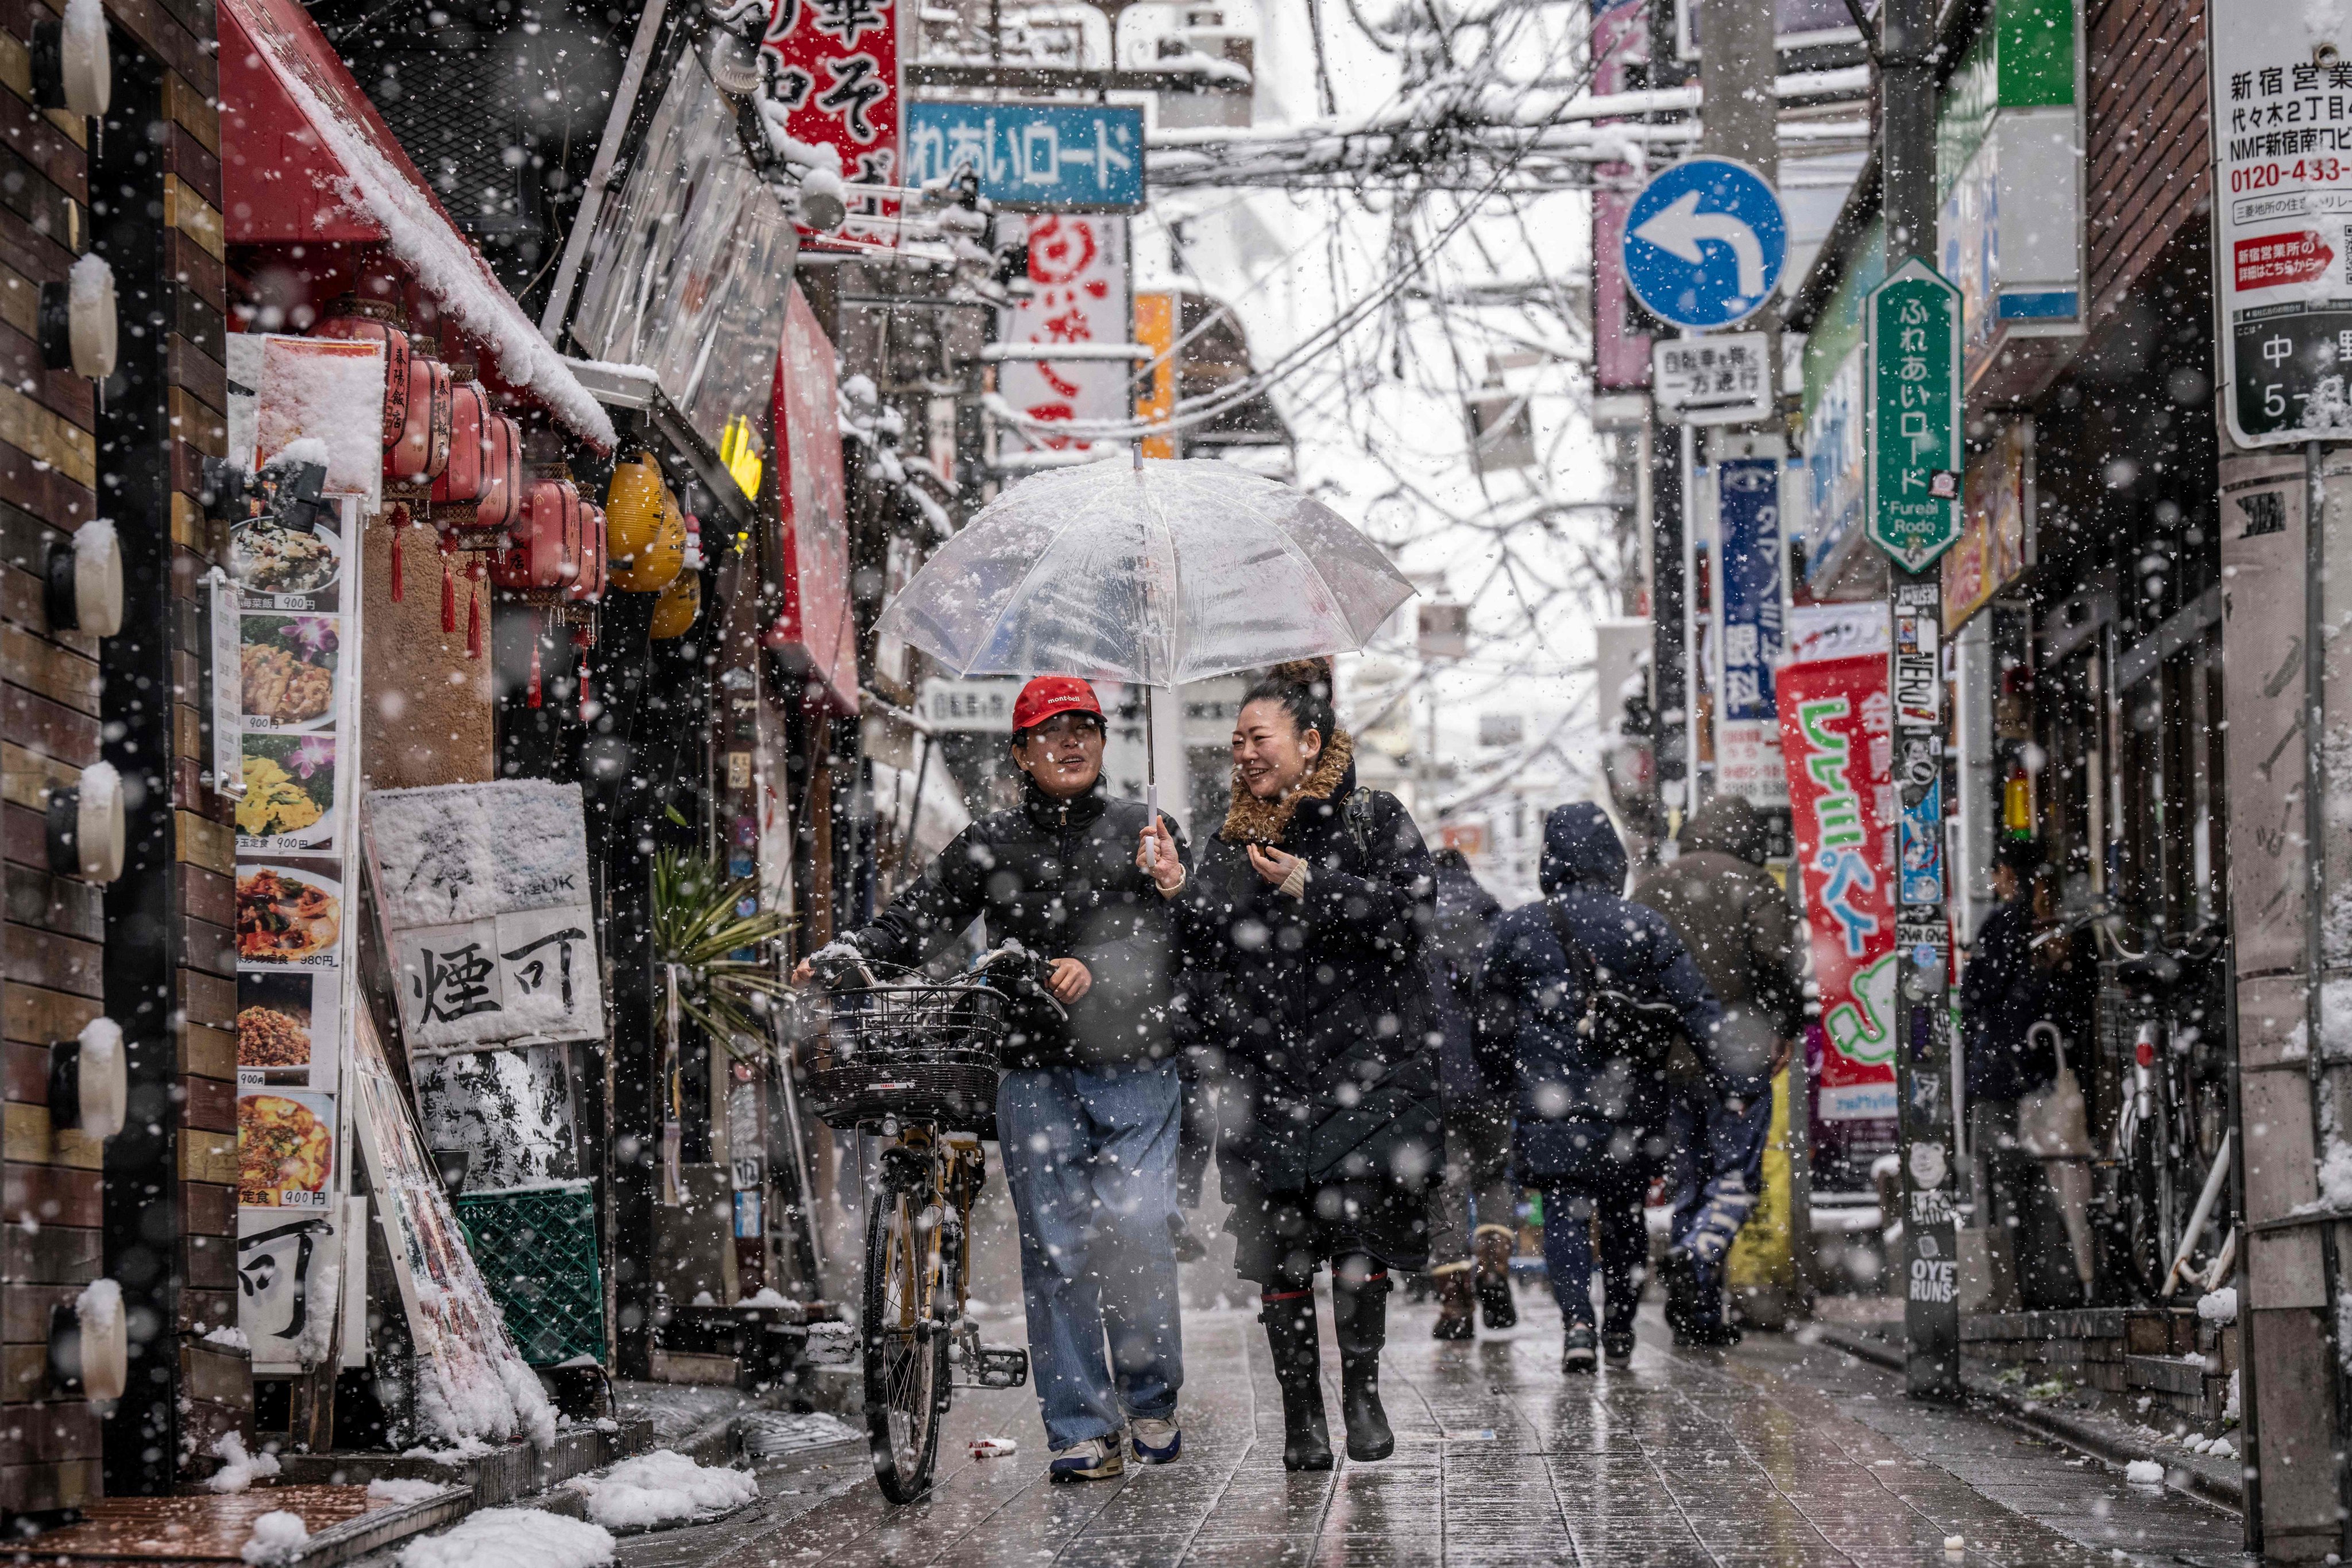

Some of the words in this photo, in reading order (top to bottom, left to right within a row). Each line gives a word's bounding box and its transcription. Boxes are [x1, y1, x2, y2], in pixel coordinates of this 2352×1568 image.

[2233, 95, 2352, 134] 代々木2丁目
[2231, 157, 2352, 193] 0120-433-
[1899, 298, 1928, 495] ふれあいロード
[1895, 518, 1936, 534] Rodo
[249, 717, 279, 729] 900円
[277, 837, 308, 849] 900円
[300, 955, 334, 966] 980円
[412, 927, 587, 1033] 煙可
[284, 1191, 326, 1206] 900円
[1910, 1279, 1953, 1303] RUNS
